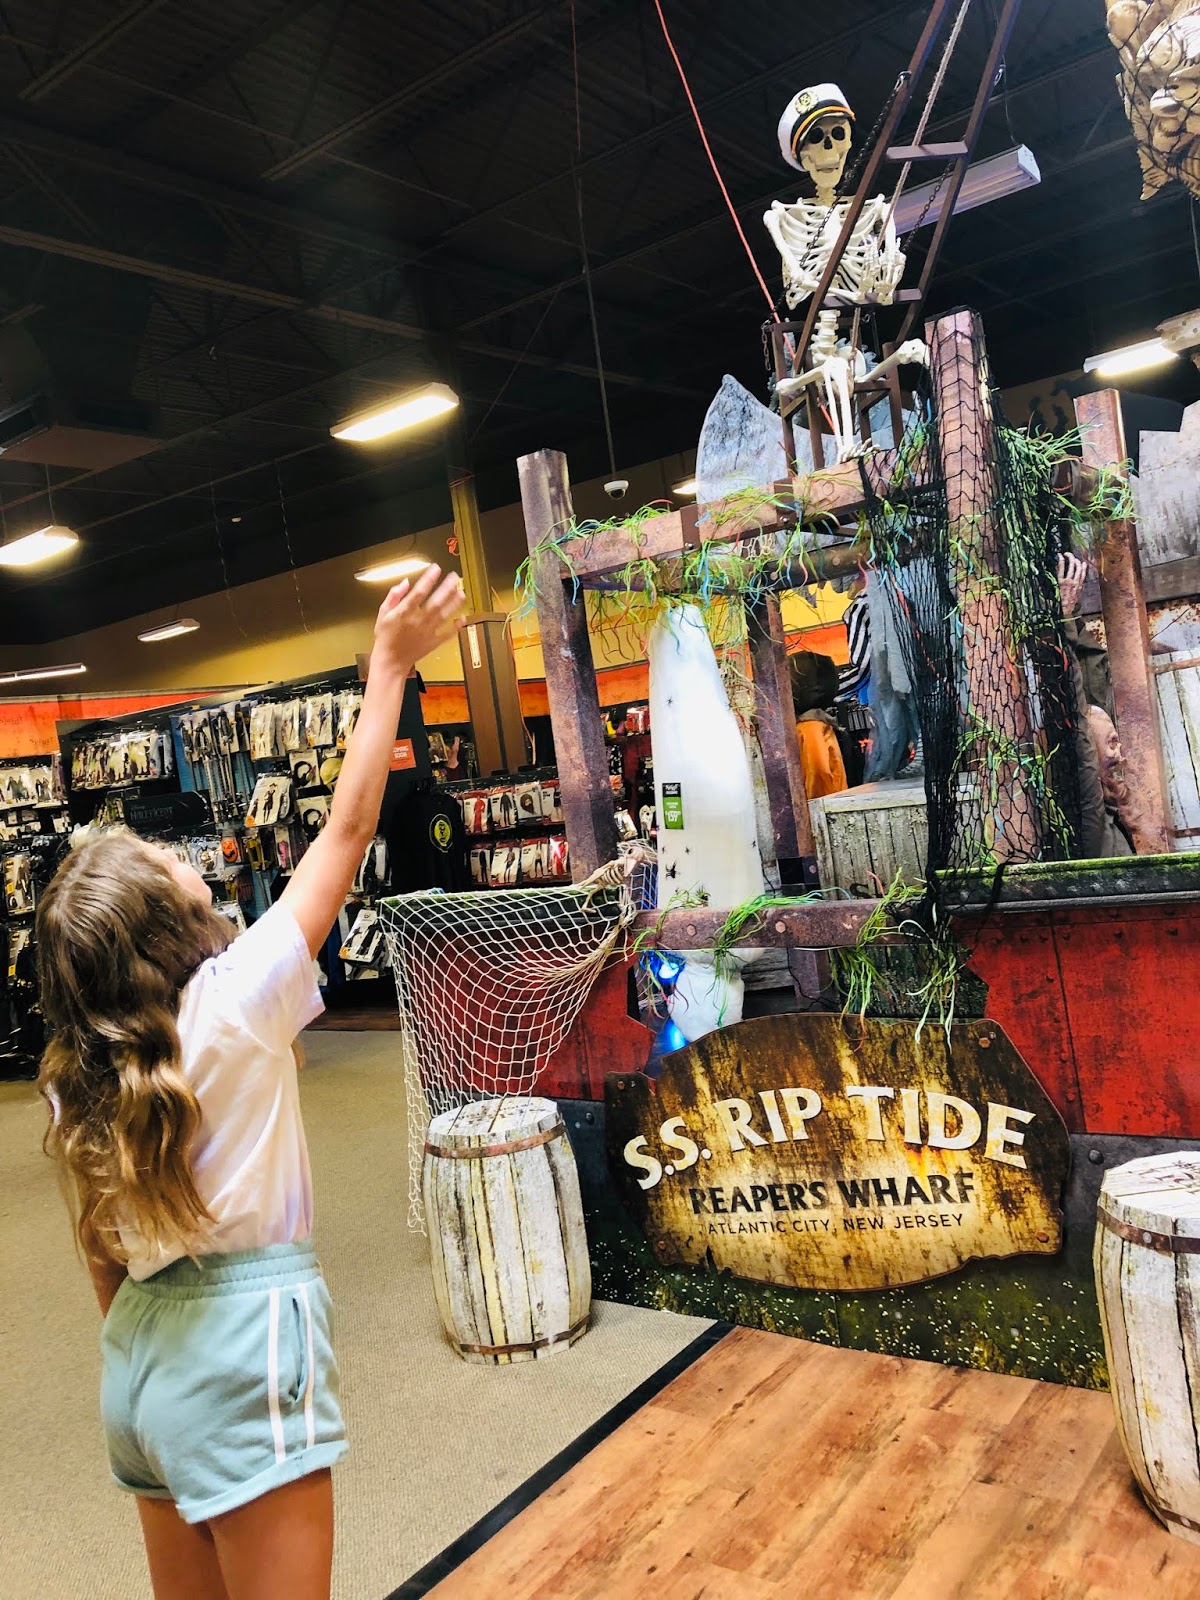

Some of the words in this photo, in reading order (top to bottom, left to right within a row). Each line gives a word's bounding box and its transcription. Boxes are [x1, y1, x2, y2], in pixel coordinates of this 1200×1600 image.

[392, 745, 409, 753] OMING
[130, 807, 173, 821] MALEFICENT
[623, 1116, 712, 1190] S.S.
[714, 1087, 822, 1152] RIP
[845, 1085, 1037, 1169] TIDE
[689, 1181, 827, 1214] REAPER'S
[836, 1171, 975, 1208] WHARF
[708, 1221, 786, 1235] ATLANTIC
[793, 1218, 838, 1234] CITY,
[843, 1216, 884, 1231] NEW
[894, 1213, 963, 1229] JERSEY
